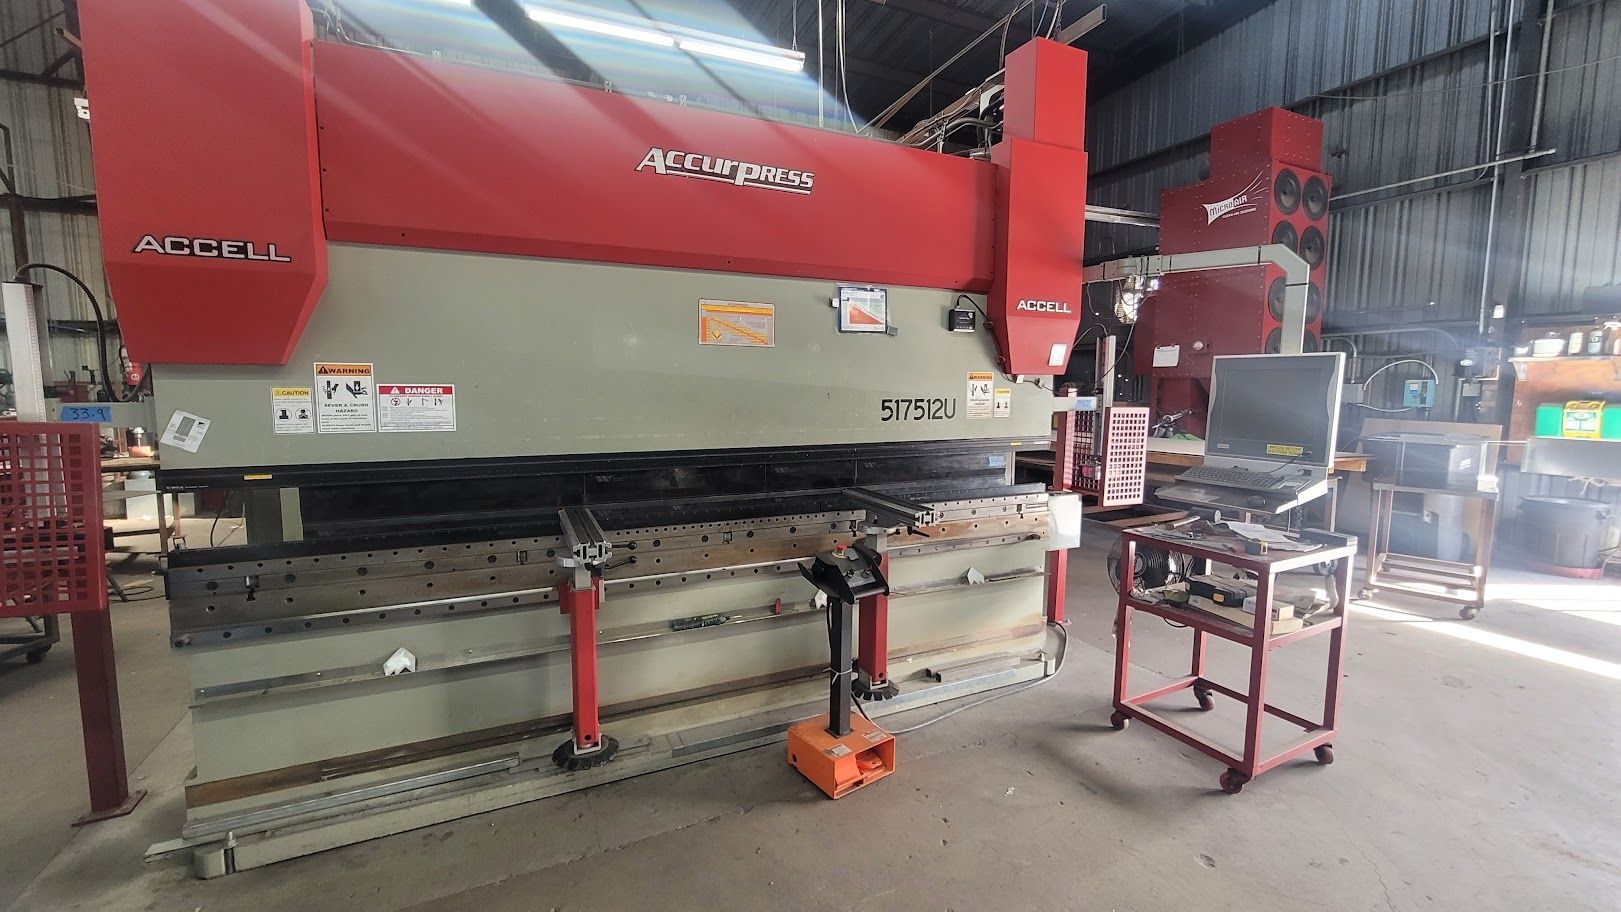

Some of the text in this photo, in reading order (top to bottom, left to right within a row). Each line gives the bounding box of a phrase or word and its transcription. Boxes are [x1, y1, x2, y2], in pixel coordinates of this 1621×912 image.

[133, 235, 292, 263] ACCELL
[1016, 300, 1072, 313] ACCELL
[881, 398, 957, 421] 517512U
